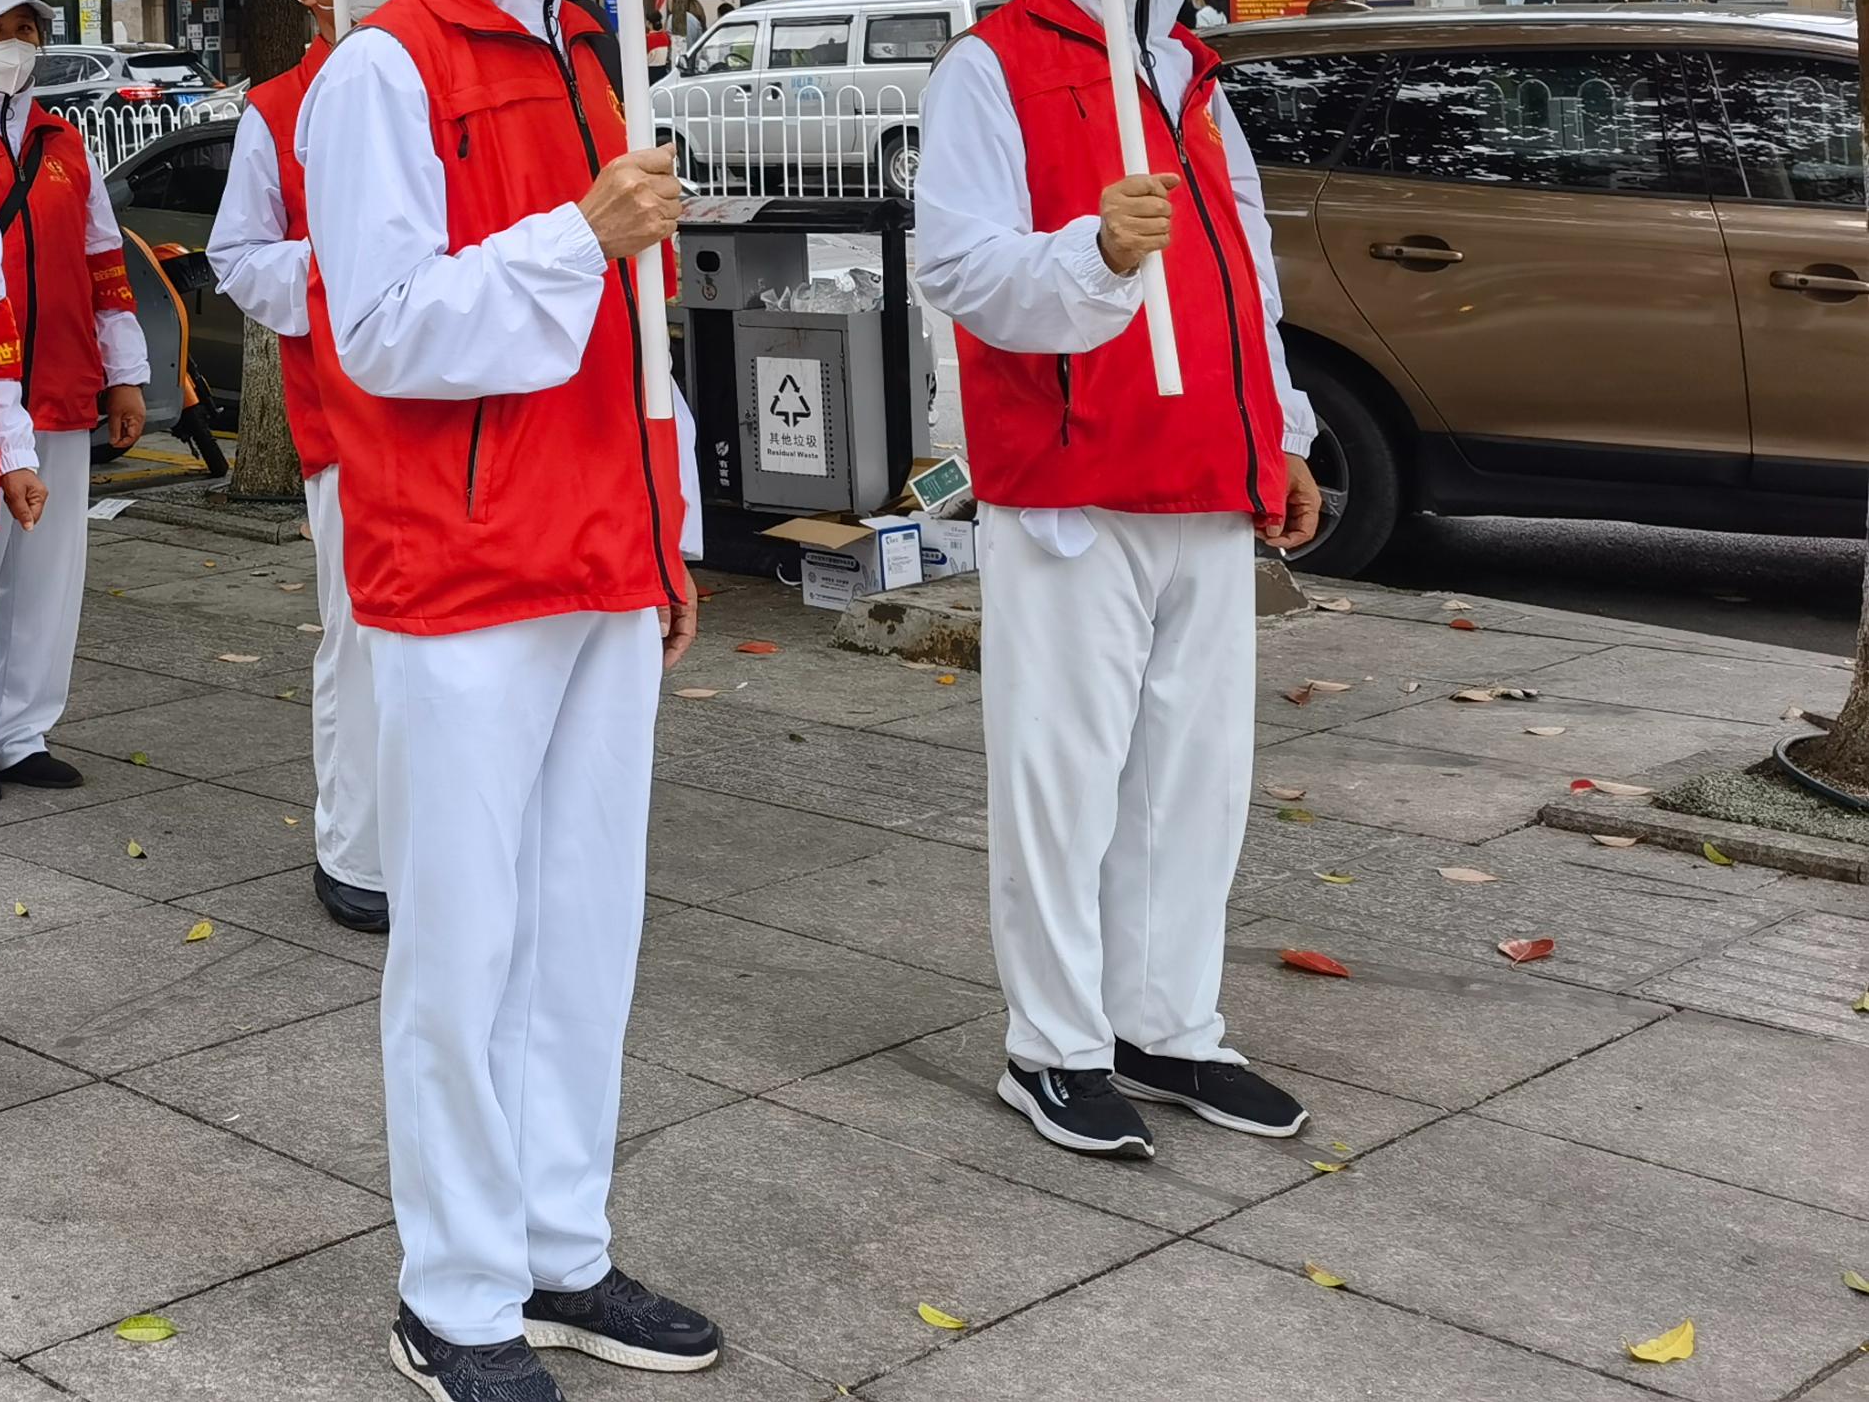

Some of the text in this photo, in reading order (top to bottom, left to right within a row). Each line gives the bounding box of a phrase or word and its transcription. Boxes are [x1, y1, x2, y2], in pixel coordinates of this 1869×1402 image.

[769, 432, 818, 448] 其他垃圾
[767, 448, 819, 459] Residual Waste
